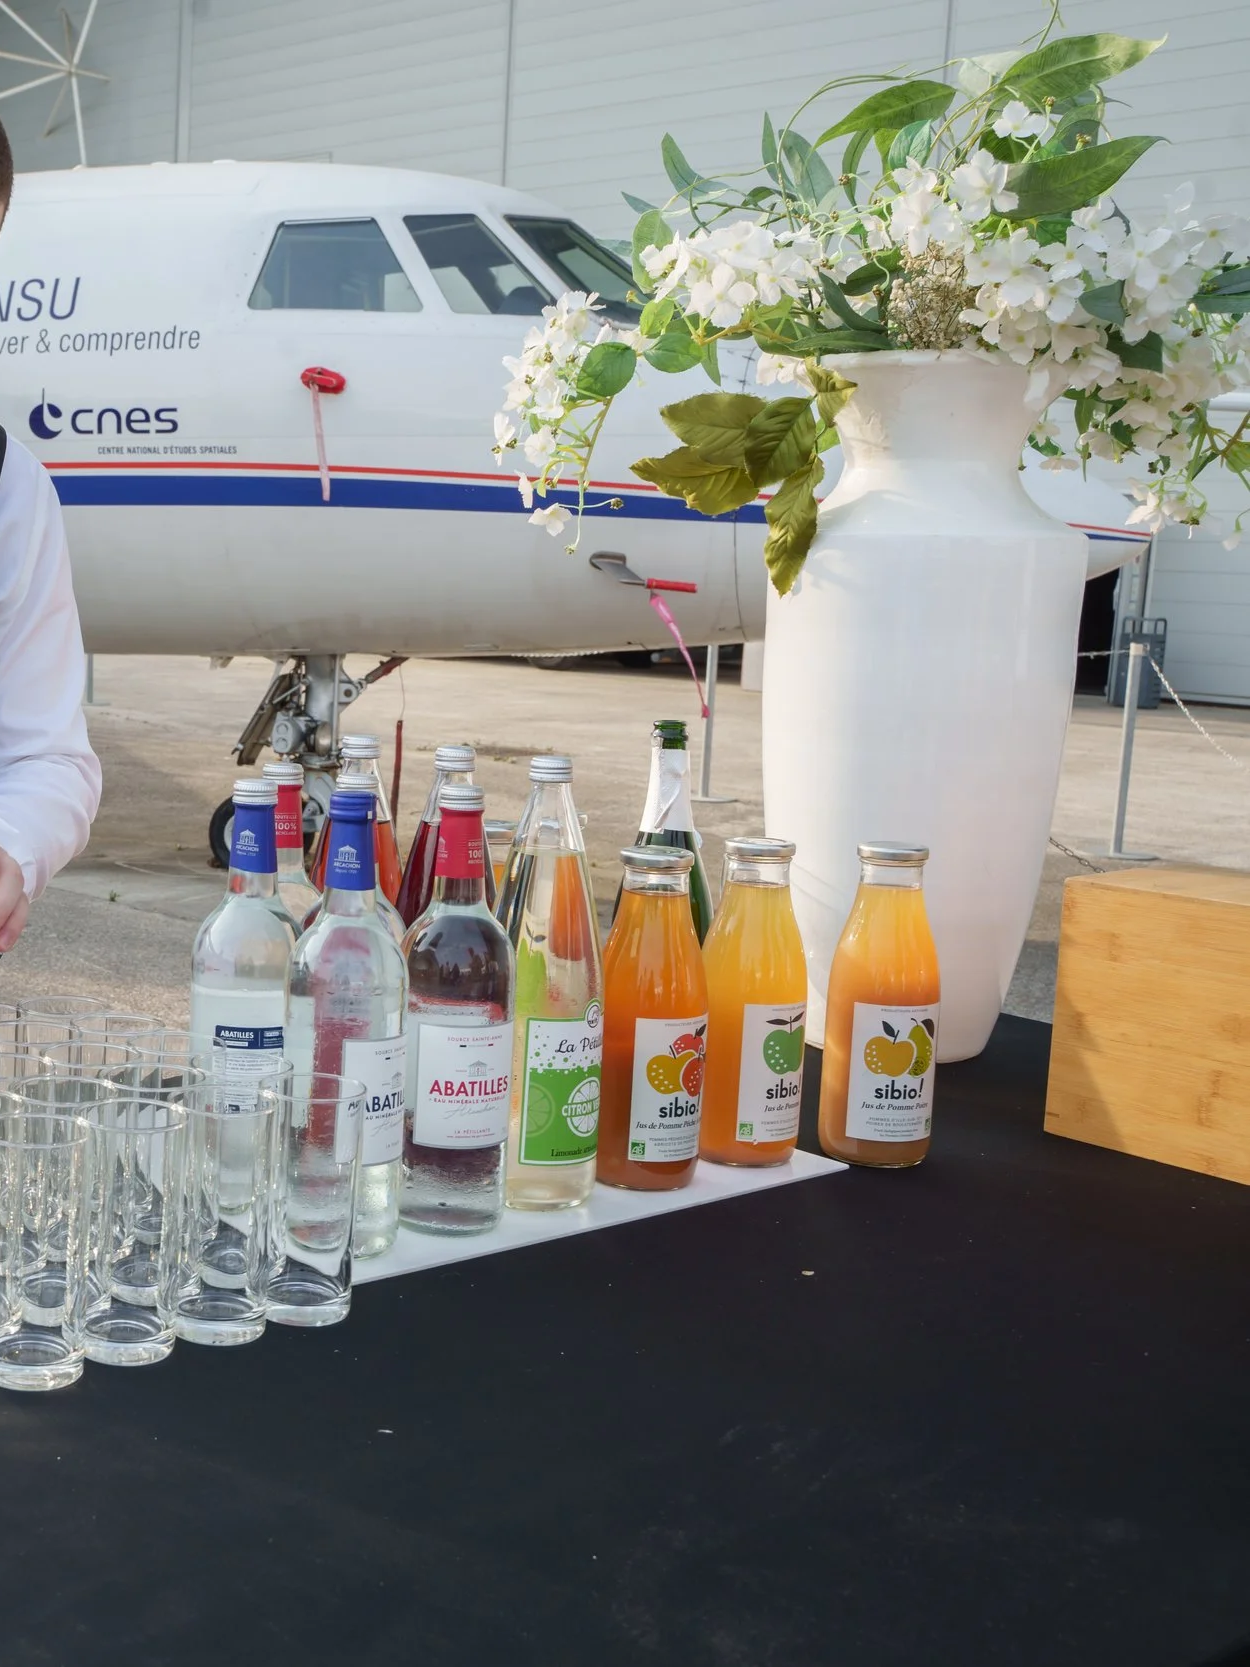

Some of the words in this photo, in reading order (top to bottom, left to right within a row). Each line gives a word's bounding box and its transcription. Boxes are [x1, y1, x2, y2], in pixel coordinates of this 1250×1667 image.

[36, 328, 51, 353] &
[58, 325, 201, 356] comprendre
[70, 406, 179, 435] cnes
[97, 446, 124, 455] CENTRE
[127, 446, 161, 455] NATIONAL
[163, 444, 197, 455] D'ÉTUDES
[199, 445, 238, 455] SPATIALES
[274, 822, 297, 830] 100%
[220, 1030, 254, 1039] ABATILLES
[554, 1038, 577, 1054] La
[429, 1075, 508, 1097] ABATILLES
[873, 1077, 925, 1101] sibio!
[561, 1101, 593, 1117] CITRON
[764, 1105, 776, 1113] Jus
[776, 1103, 784, 1111] de
[861, 1101, 874, 1110] Jus
[875, 1102, 886, 1111] de
[887, 1103, 915, 1112] Pomme
[635, 1121, 648, 1129] Jus
[658, 1122, 683, 1130] Pomme
